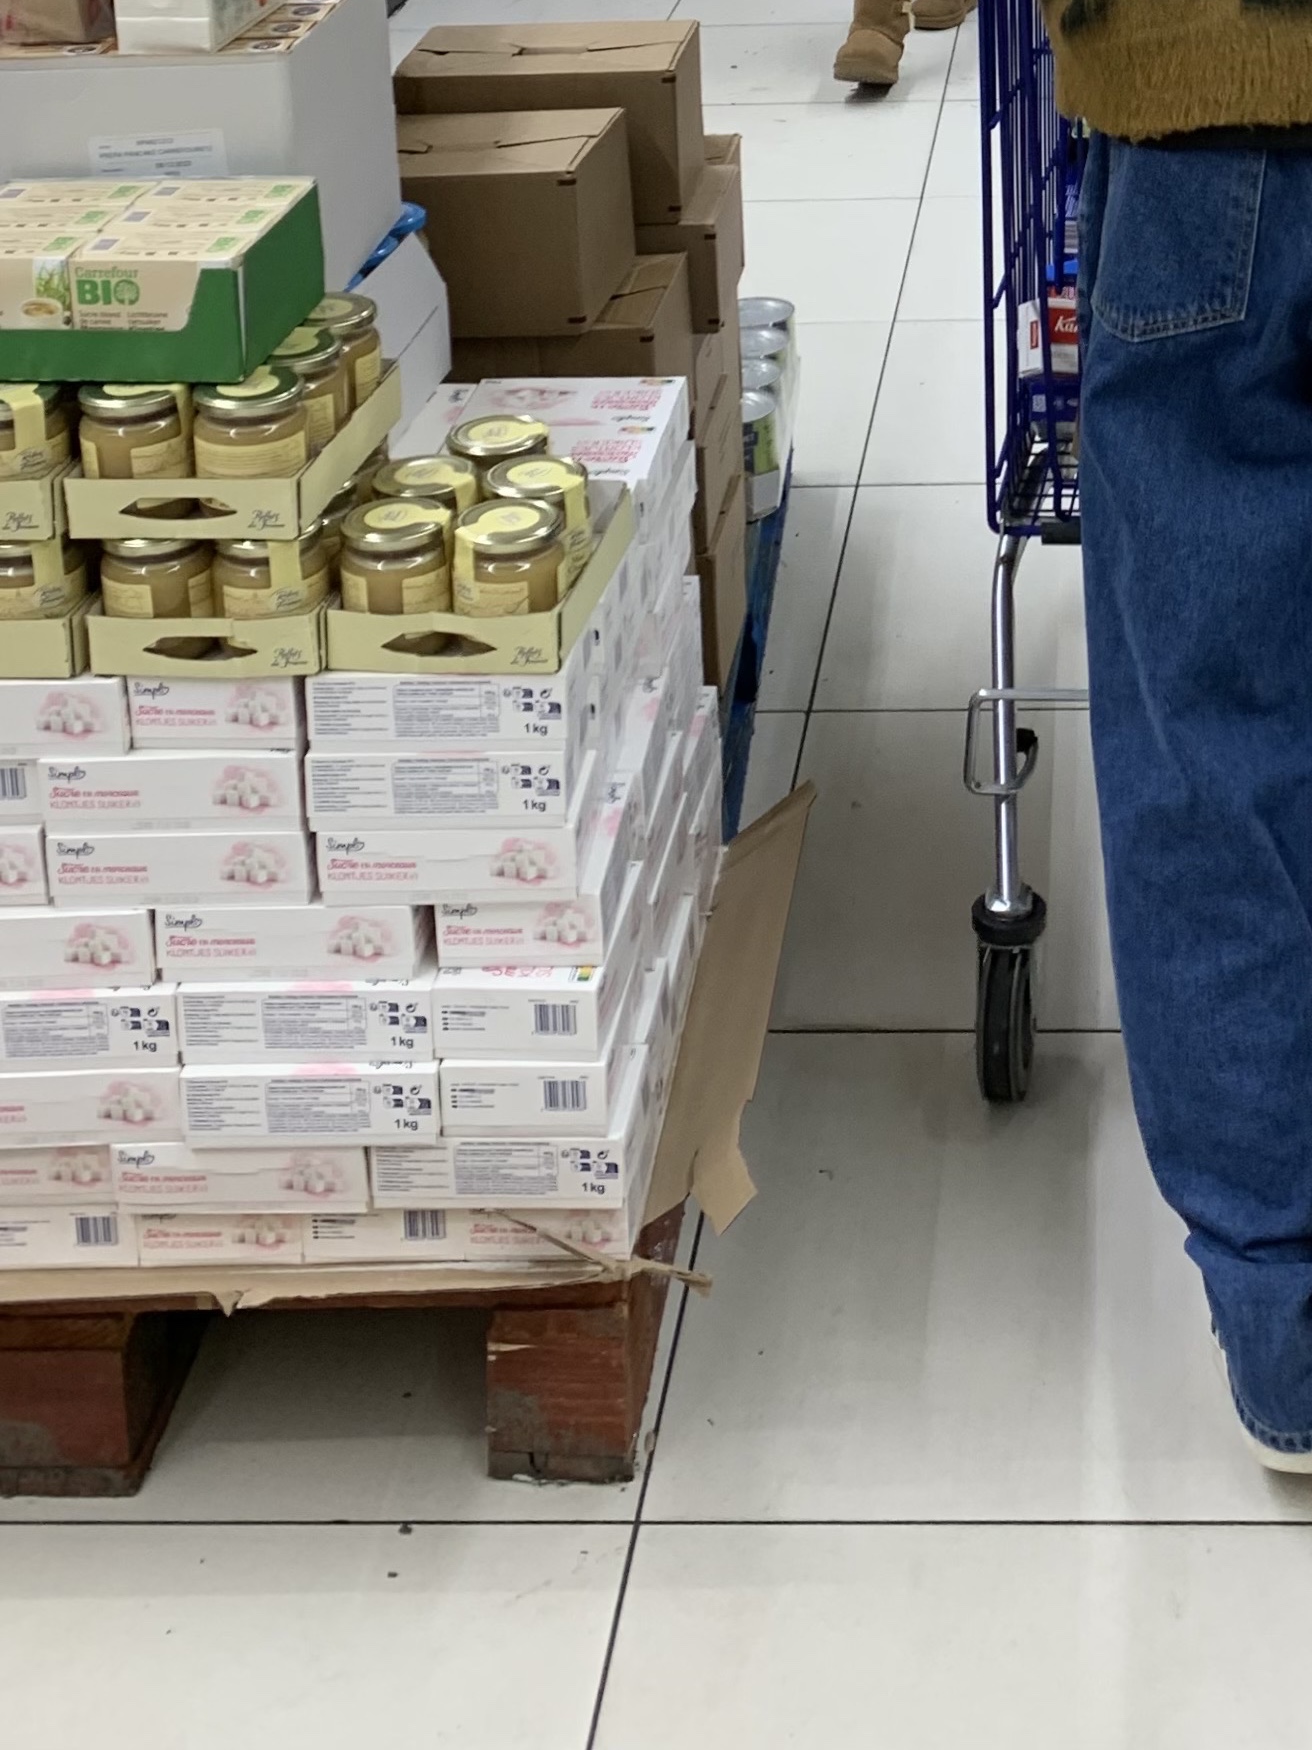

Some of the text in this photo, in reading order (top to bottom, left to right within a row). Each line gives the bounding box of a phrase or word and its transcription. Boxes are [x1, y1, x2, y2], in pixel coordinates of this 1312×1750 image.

[75, 265, 139, 279] Carrefour
[76, 279, 141, 305] BIO
[524, 723, 548, 737] 1 kg
[523, 799, 546, 813] 1 kg
[133, 1040, 158, 1053] 1 kg
[390, 1036, 414, 1050] 1 kg
[394, 1118, 418, 1132] 1 kg
[581, 1182, 606, 1195] 1 kg
